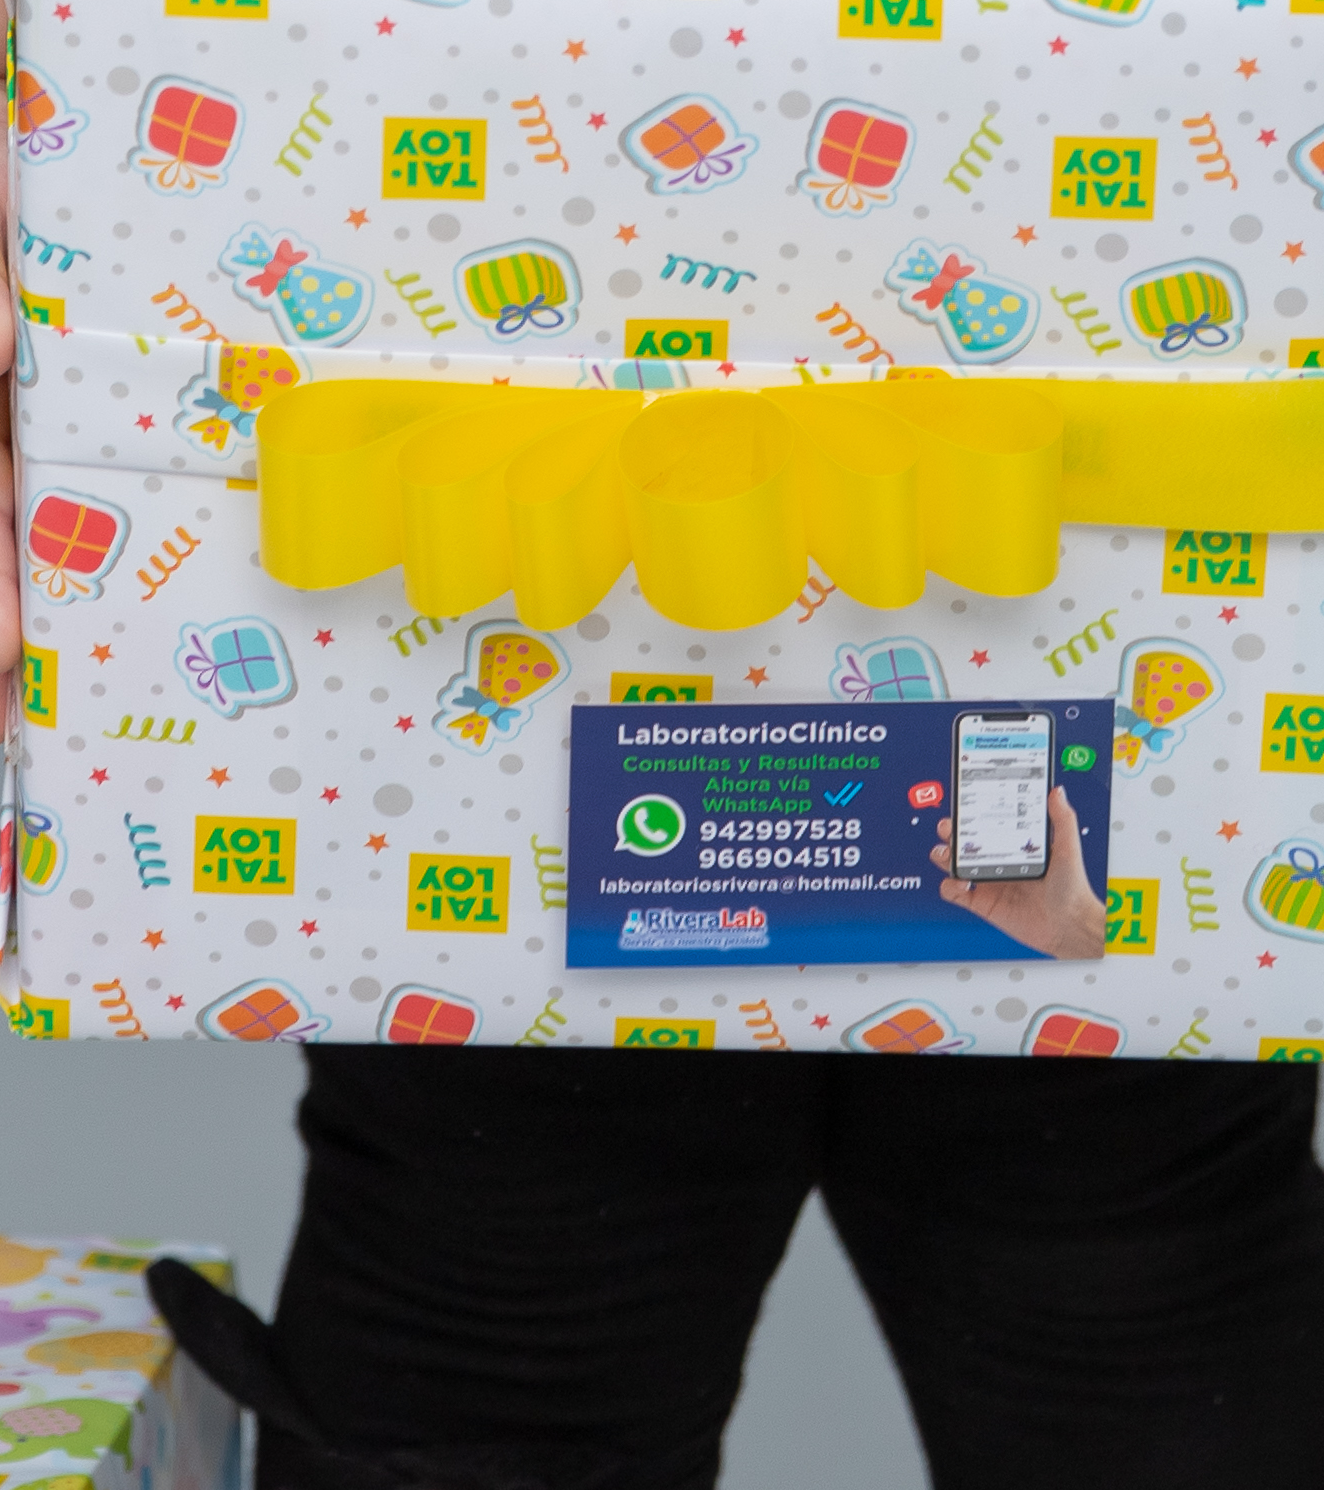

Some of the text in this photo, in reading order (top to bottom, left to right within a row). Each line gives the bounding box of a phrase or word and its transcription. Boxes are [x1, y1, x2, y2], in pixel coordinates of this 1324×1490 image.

[393, 130, 471, 156] LOY
[1063, 149, 1141, 176] LOY
[636, 332, 712, 357] LOY
[1175, 531, 1252, 554] LOY
[618, 720, 888, 745] LaboratorioClínico
[623, 752, 881, 775] Consultas y Resultados
[704, 774, 810, 794] Ahora vía
[702, 796, 813, 815] WhatsApp
[205, 829, 280, 853] LOY
[700, 819, 862, 842] 942997528
[699, 846, 861, 869] 966904519
[418, 867, 494, 891] LOY
[600, 874, 922, 895] laboratoriosrivera@hotmail.com
[648, 907, 765, 928] RiveraLab
[624, 1028, 700, 1047] LOY
